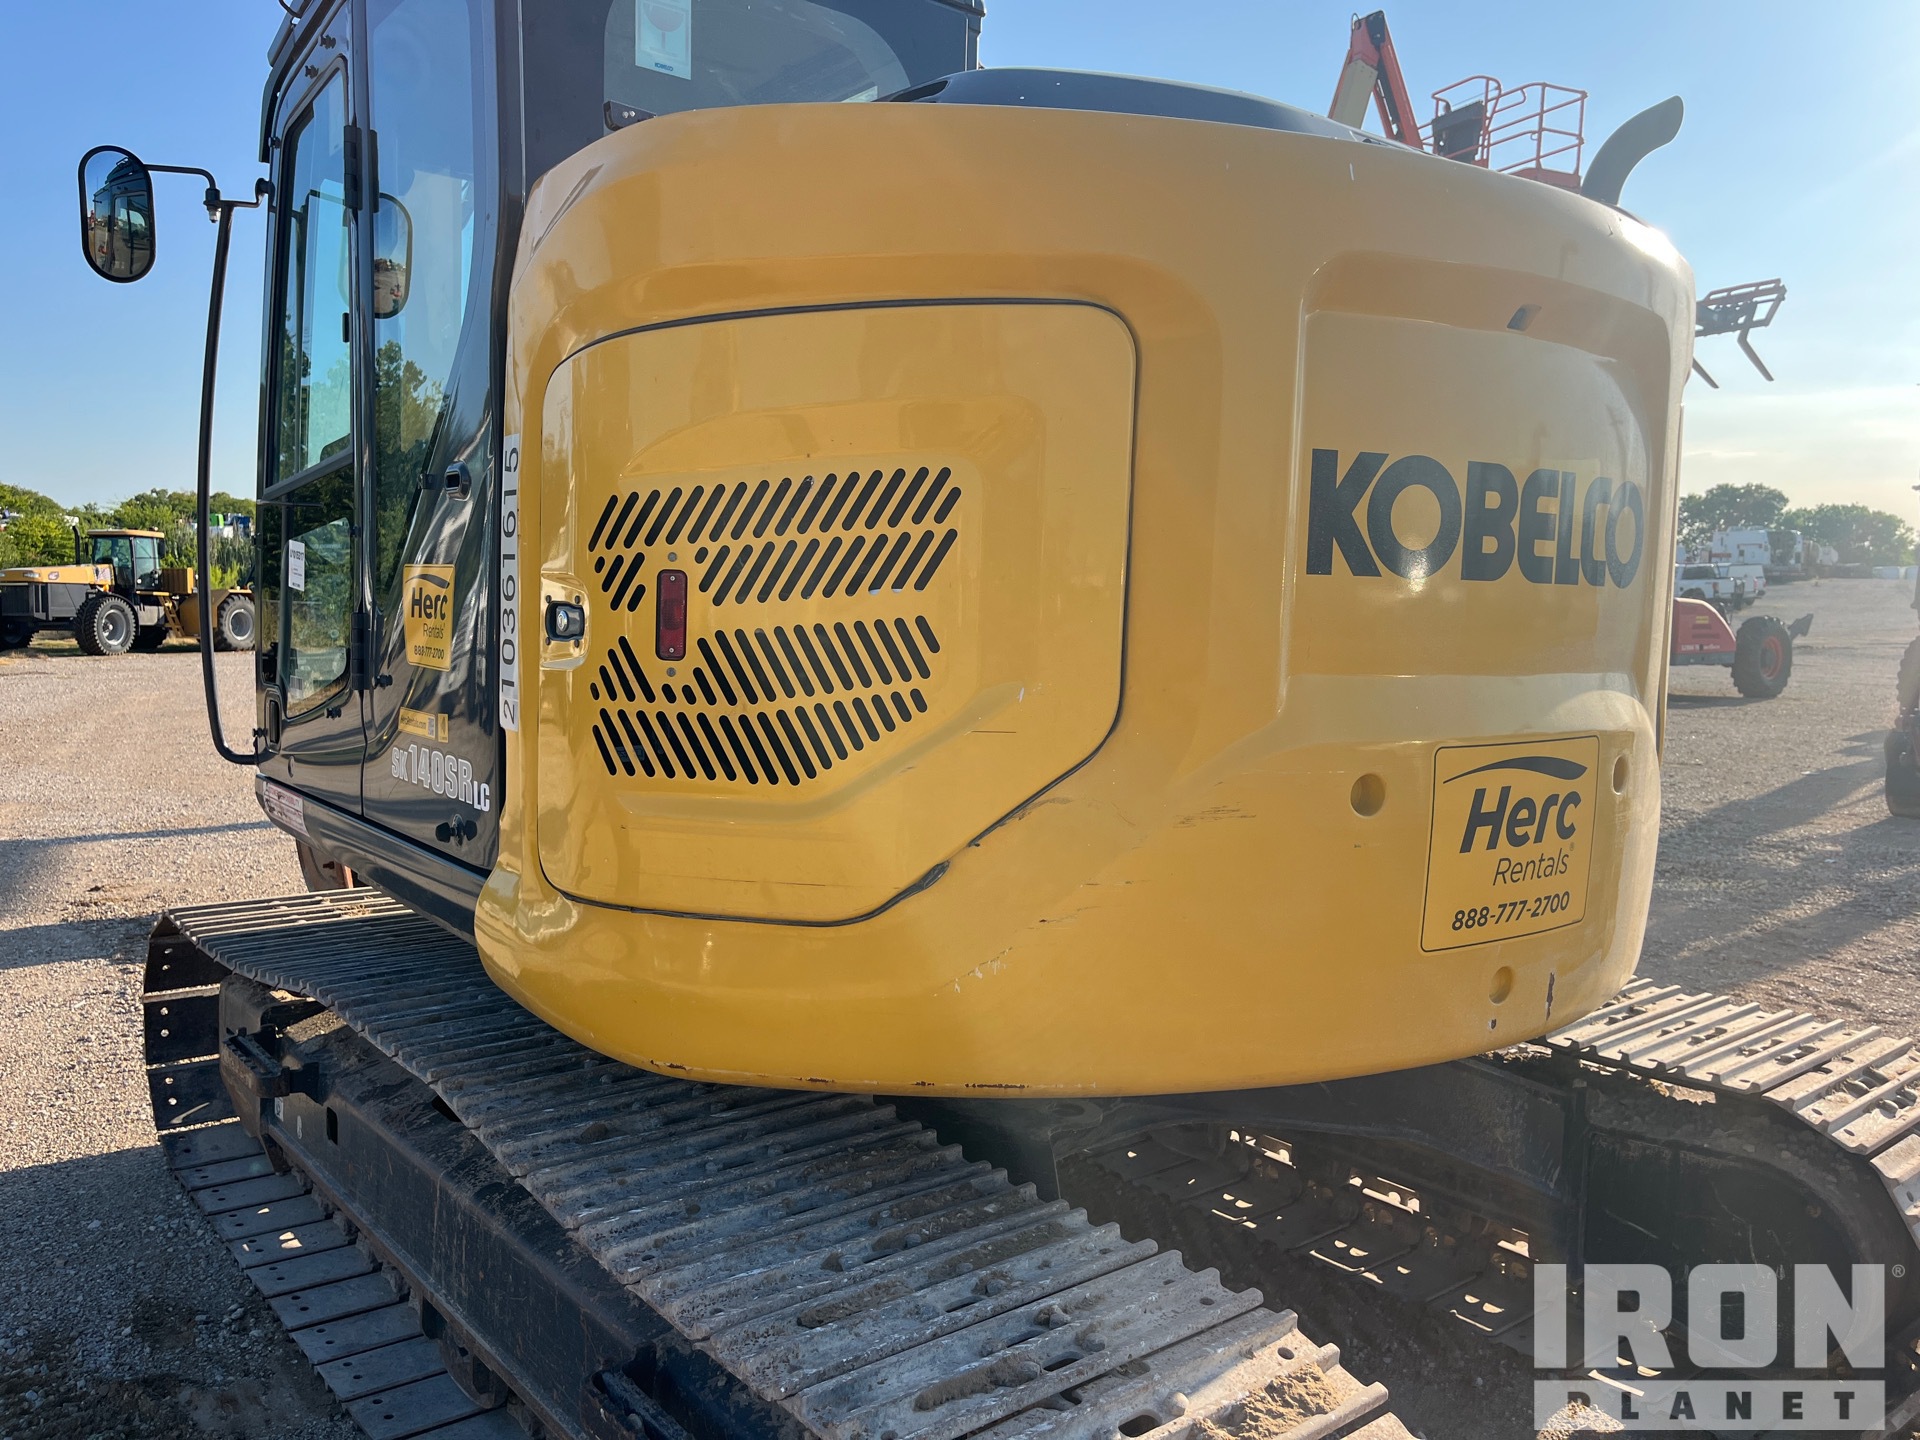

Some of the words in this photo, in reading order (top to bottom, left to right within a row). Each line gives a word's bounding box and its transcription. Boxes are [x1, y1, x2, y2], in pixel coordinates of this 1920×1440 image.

[1305, 447, 1645, 590] KOBELCO
[411, 586, 448, 621] Herc
[501, 447, 519, 725] 210361615
[1459, 785, 1582, 854] Herc
[1492, 847, 1570, 886] Rentals
[1451, 890, 1570, 931] 888-777-2700
